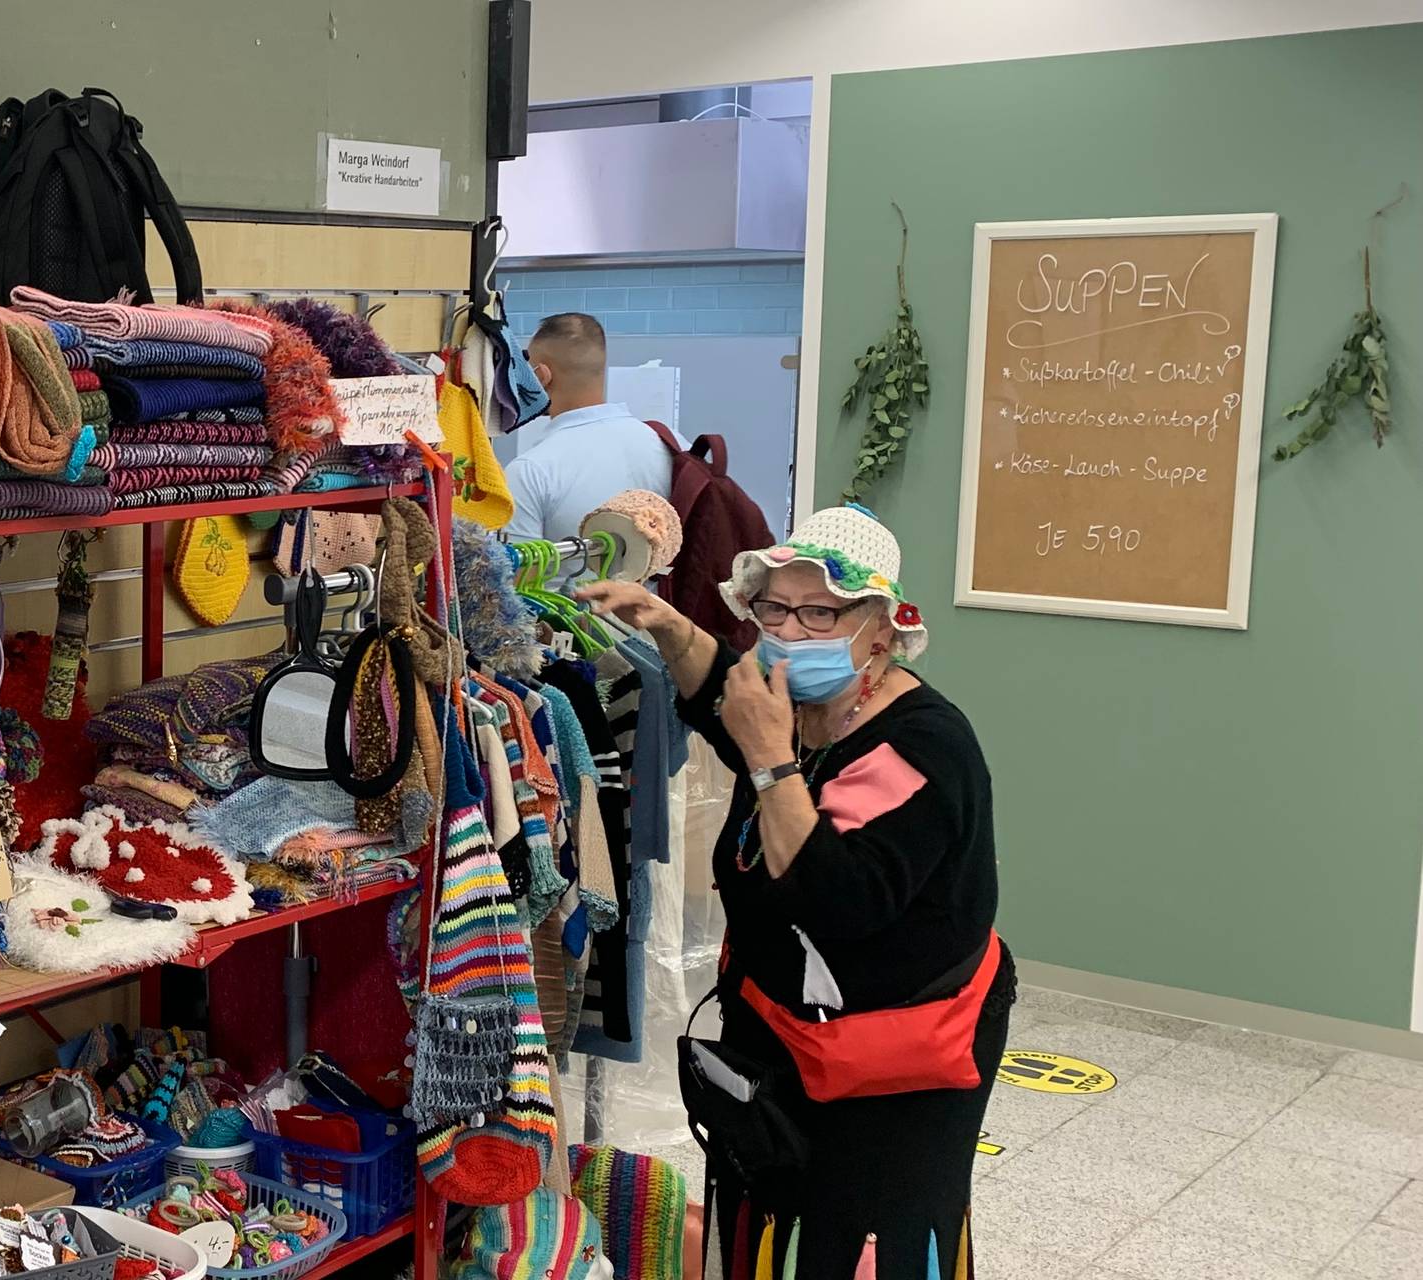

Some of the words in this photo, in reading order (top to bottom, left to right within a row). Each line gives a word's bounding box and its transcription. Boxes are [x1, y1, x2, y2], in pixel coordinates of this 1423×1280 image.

[338, 151, 369, 169] Marga
[371, 153, 410, 169] Weindorf
[1081, 524, 1141, 555] 5,90
